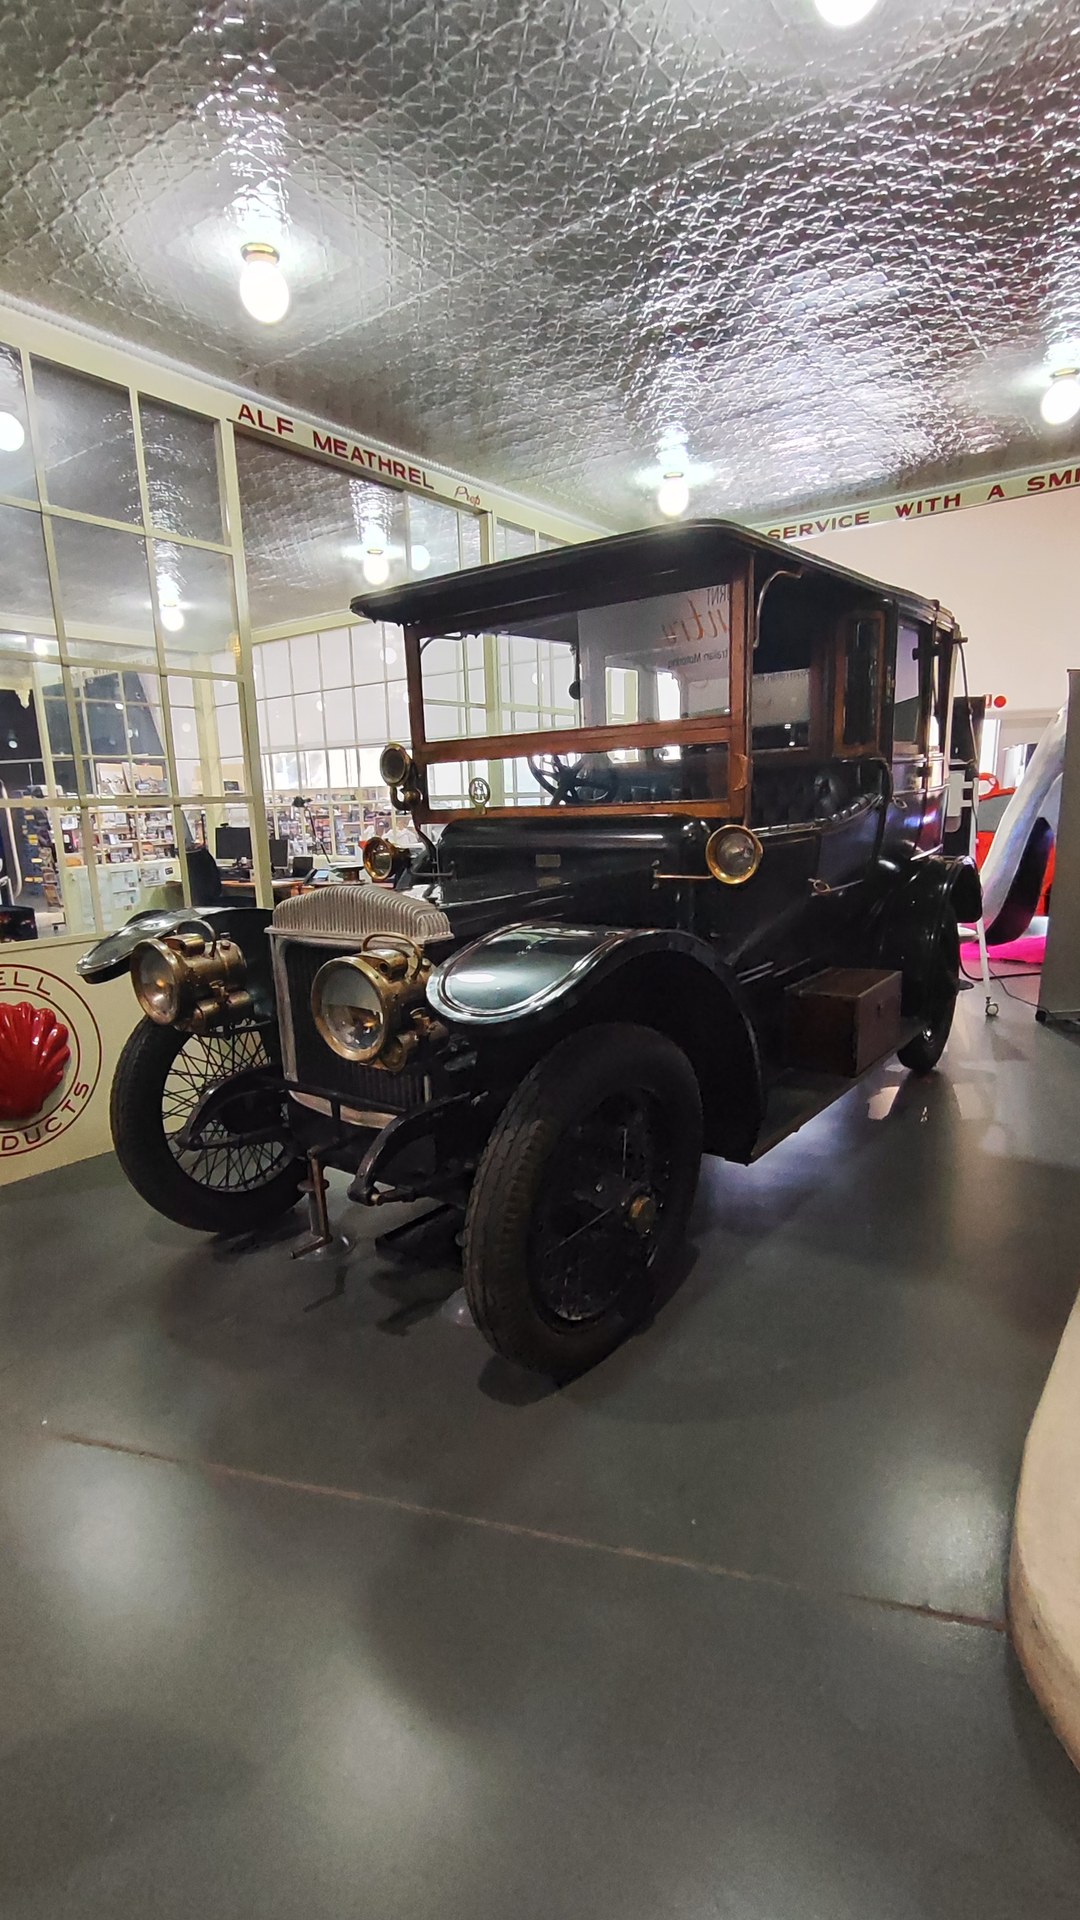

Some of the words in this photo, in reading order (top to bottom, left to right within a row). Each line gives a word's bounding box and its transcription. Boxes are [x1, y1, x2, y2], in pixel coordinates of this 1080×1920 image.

[238, 403, 294, 435] ALF
[312, 430, 435, 490] MEATHREL
[767, 511, 871, 540] SERVICE
[895, 493, 962, 518] WITH
[986, 484, 1006, 501] A
[1, 1082, 90, 1151] DUCTS
